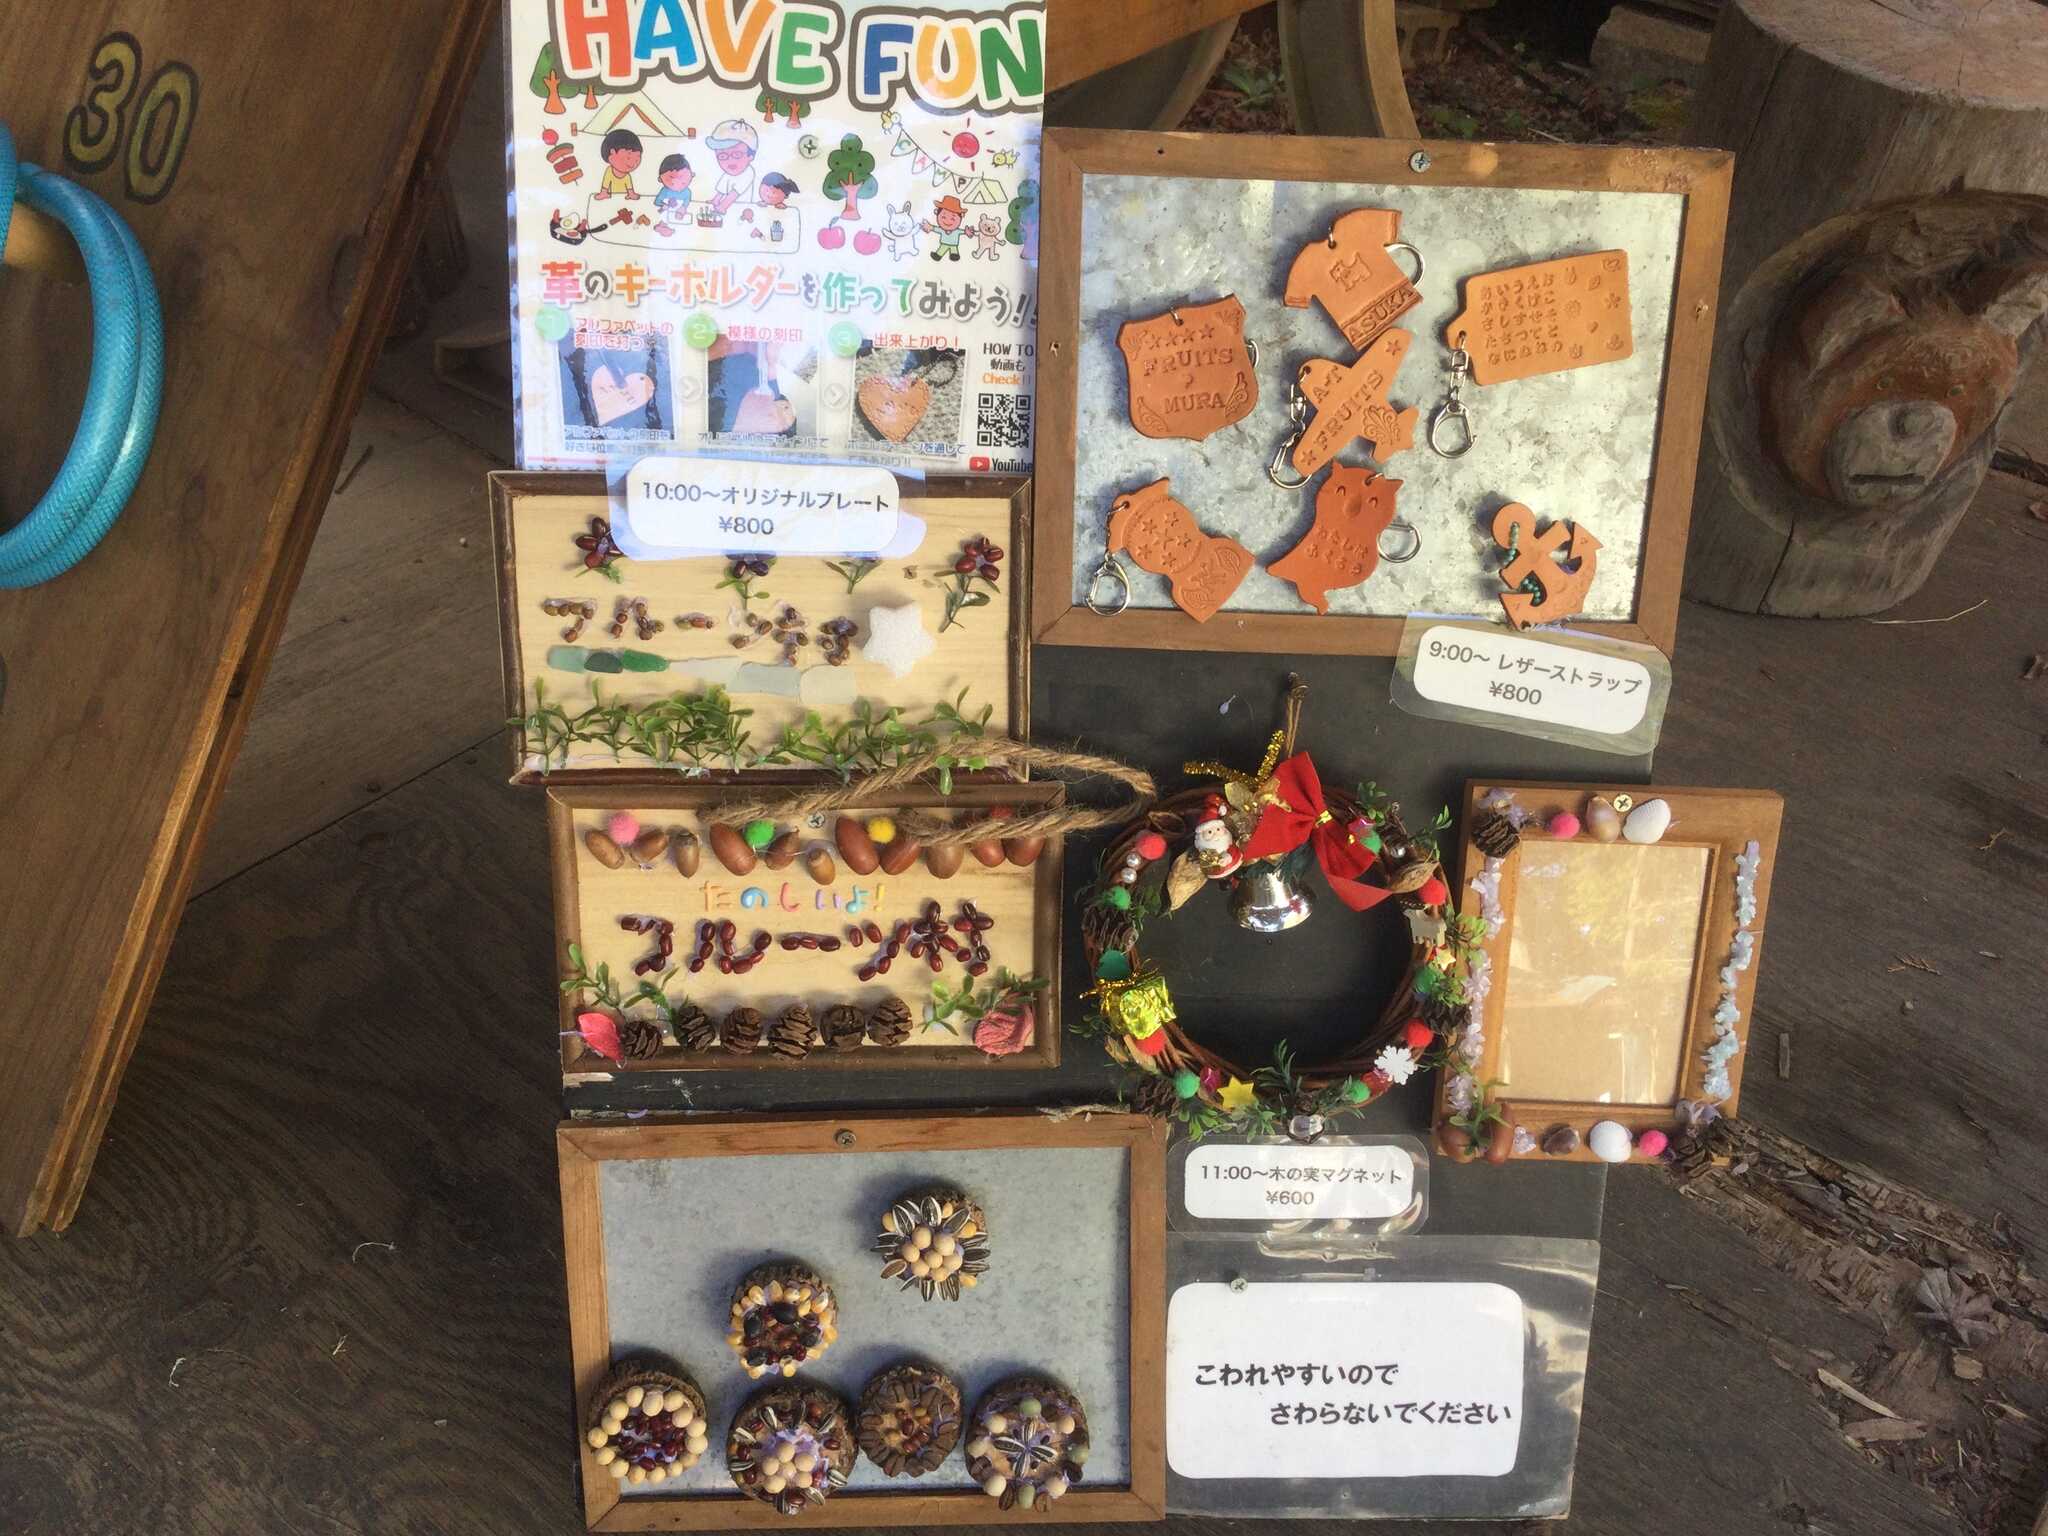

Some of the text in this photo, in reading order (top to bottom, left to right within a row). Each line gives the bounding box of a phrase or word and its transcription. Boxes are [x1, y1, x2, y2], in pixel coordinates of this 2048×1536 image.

[564, 0, 1044, 101] HAVE FUN
[62, 30, 199, 205] 30
[728, 325, 803, 343] 模様の刻印
[983, 342, 1034, 356] HOW TO
[1143, 347, 1233, 377] FRUITS
[1164, 391, 1226, 414] MURA
[991, 458, 1034, 473] YouTube
[718, 516, 775, 536] ¥800
[1498, 654, 1643, 695] レザーストラップ
[1488, 681, 1543, 705] ¥800
[1265, 1191, 1315, 1206] ¥600
[1194, 1363, 1400, 1387] こわれやすいので
[1269, 1402, 1512, 1426] さわらないでください
